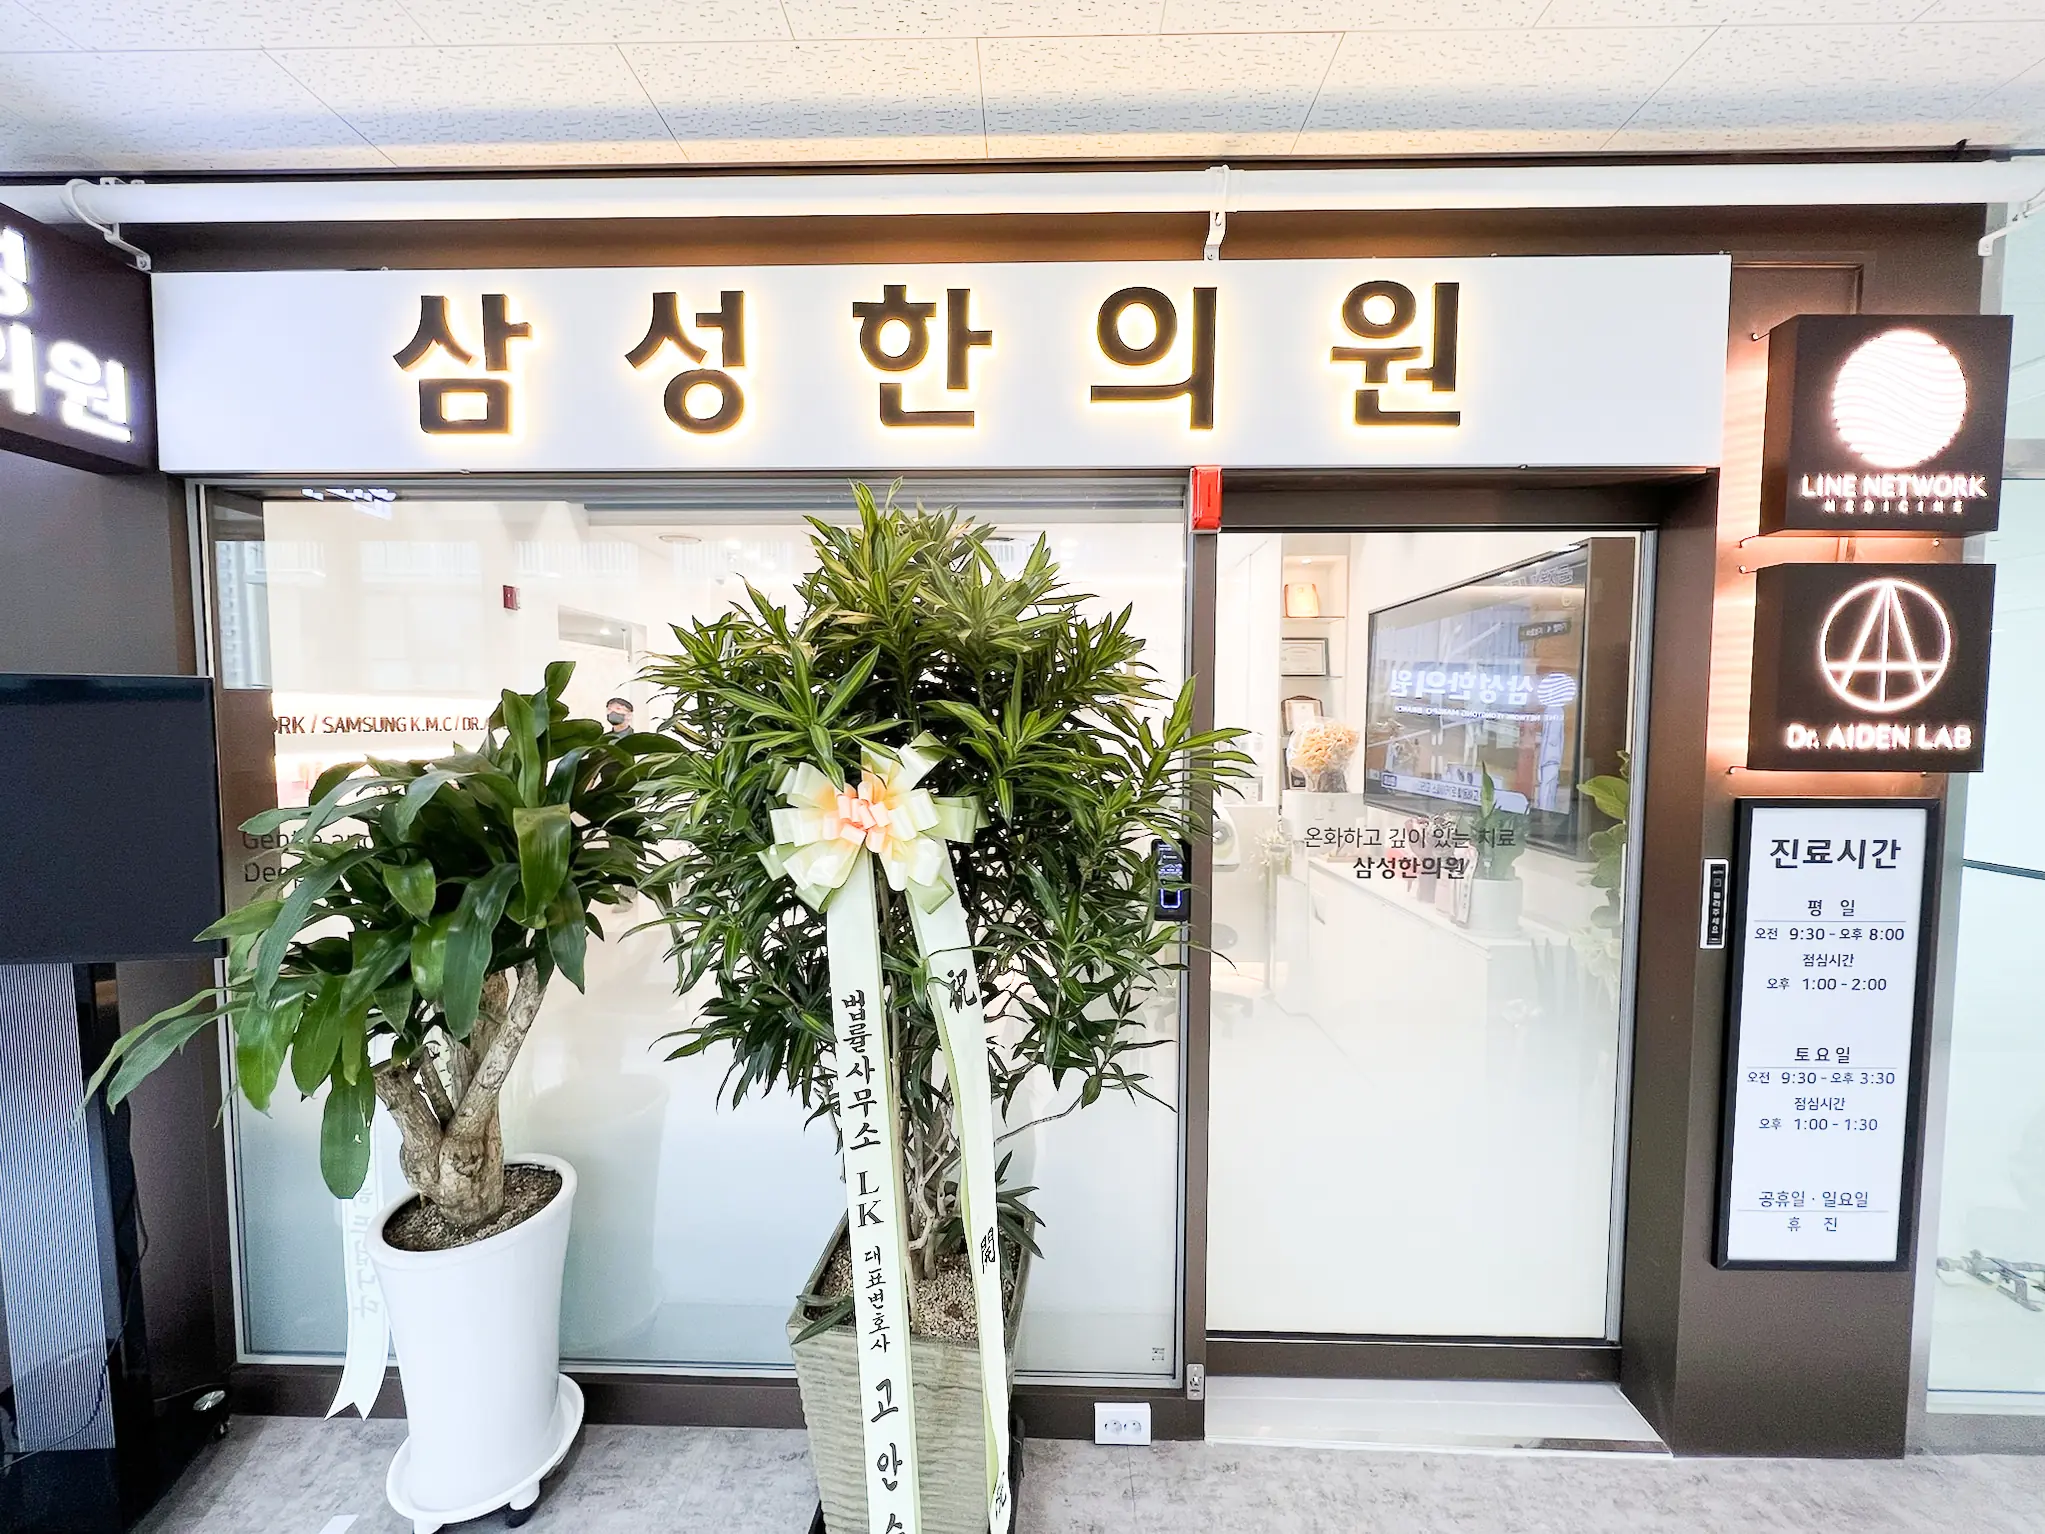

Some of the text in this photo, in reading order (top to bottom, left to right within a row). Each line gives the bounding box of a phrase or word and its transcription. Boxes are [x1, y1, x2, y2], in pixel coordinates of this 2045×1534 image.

[393, 281, 1460, 434] 삼성한의원
[1801, 474, 1987, 498] LINE NETWORK
[322, 716, 407, 734] SAMSUNG
[1786, 725, 1971, 749] Dr. AIDEN LAB
[1304, 827, 1517, 848] 온화하고 깊이 있는 치료
[1770, 838, 1902, 870] 진료시간
[1353, 856, 1467, 879] 삼성한의원
[1754, 927, 1778, 941] 오전
[1789, 927, 1825, 941] 9:30
[1839, 927, 1863, 941] 오후
[1869, 927, 1905, 941] 8:00
[1802, 953, 1854, 968] 점심시간
[1766, 977, 1790, 990] 오후
[1802, 977, 1837, 990] 1:00
[1851, 977, 1887, 990] 2:00
[841, 989, 881, 1151] 법률사무소
[1747, 1071, 1770, 1084] 오전
[1781, 1072, 1817, 1084] 9:30
[1830, 1071, 1854, 1084] 오후
[1860, 1072, 1896, 1084] 3:30
[1794, 1097, 1846, 1111] 점심시간
[1759, 1117, 1782, 1130] 오후
[1794, 1118, 1828, 1130] 1:00
[1845, 1118, 1878, 1130] 1:30
[856, 1170, 884, 1228] LK
[1759, 1190, 1805, 1208] 공휴일
[1822, 1190, 1868, 1208] 일요일
[864, 1245, 891, 1354] 대표변호사
